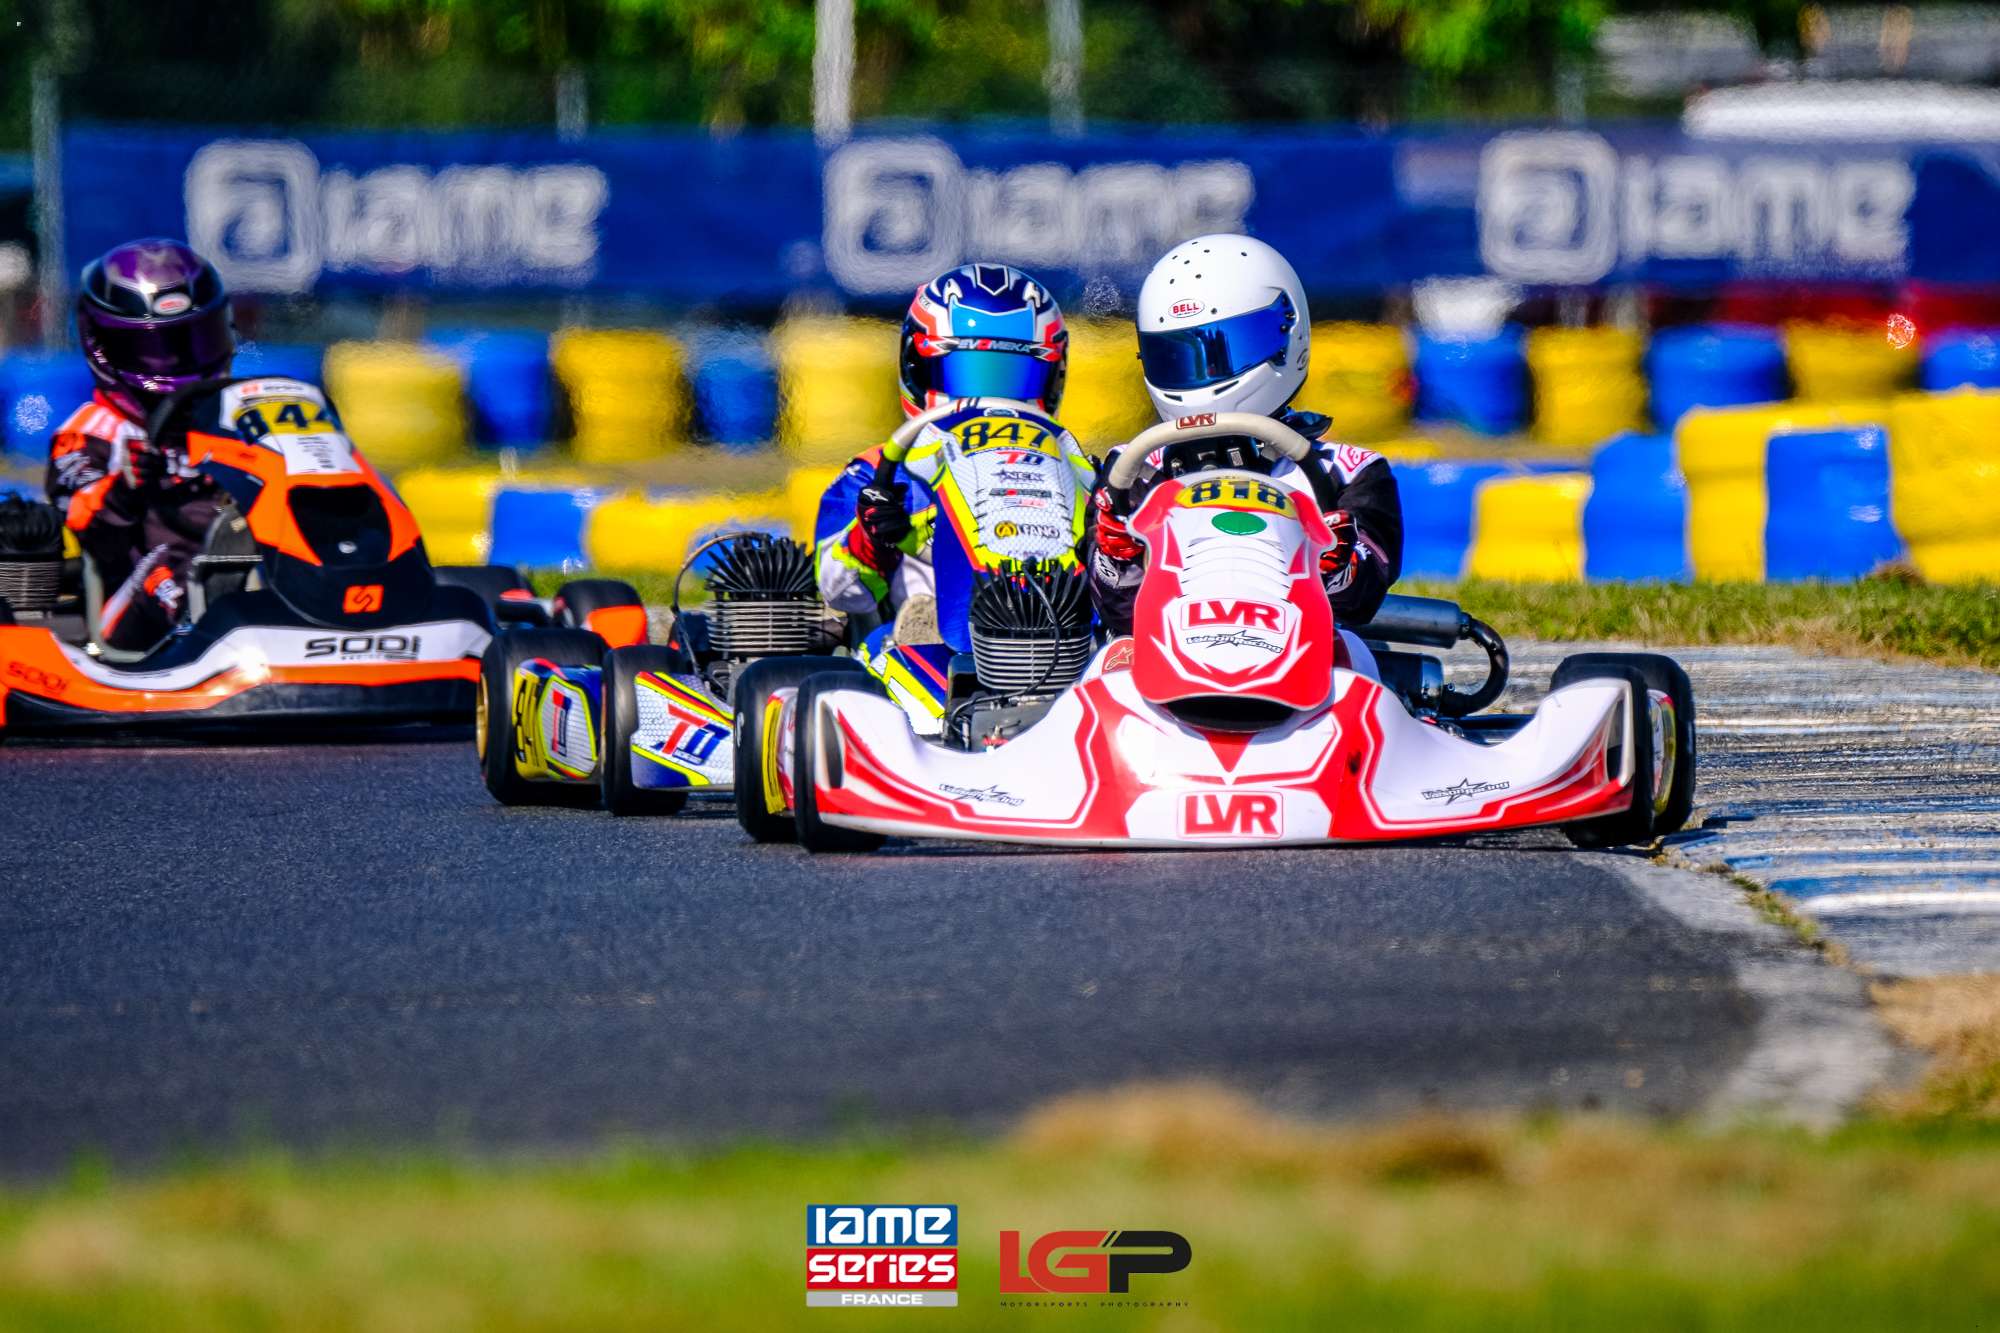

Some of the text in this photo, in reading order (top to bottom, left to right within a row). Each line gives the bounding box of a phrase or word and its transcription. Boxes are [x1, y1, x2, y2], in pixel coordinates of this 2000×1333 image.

[1173, 303, 1200, 314] BELL
[1179, 413, 1213, 428] LVR
[961, 422, 1050, 452] 847
[1191, 479, 1286, 510] 818
[994, 520, 1061, 540] ALFANO
[1189, 600, 1281, 632] LVR
[304, 635, 421, 658] SODI
[1185, 794, 1278, 835] LVR
